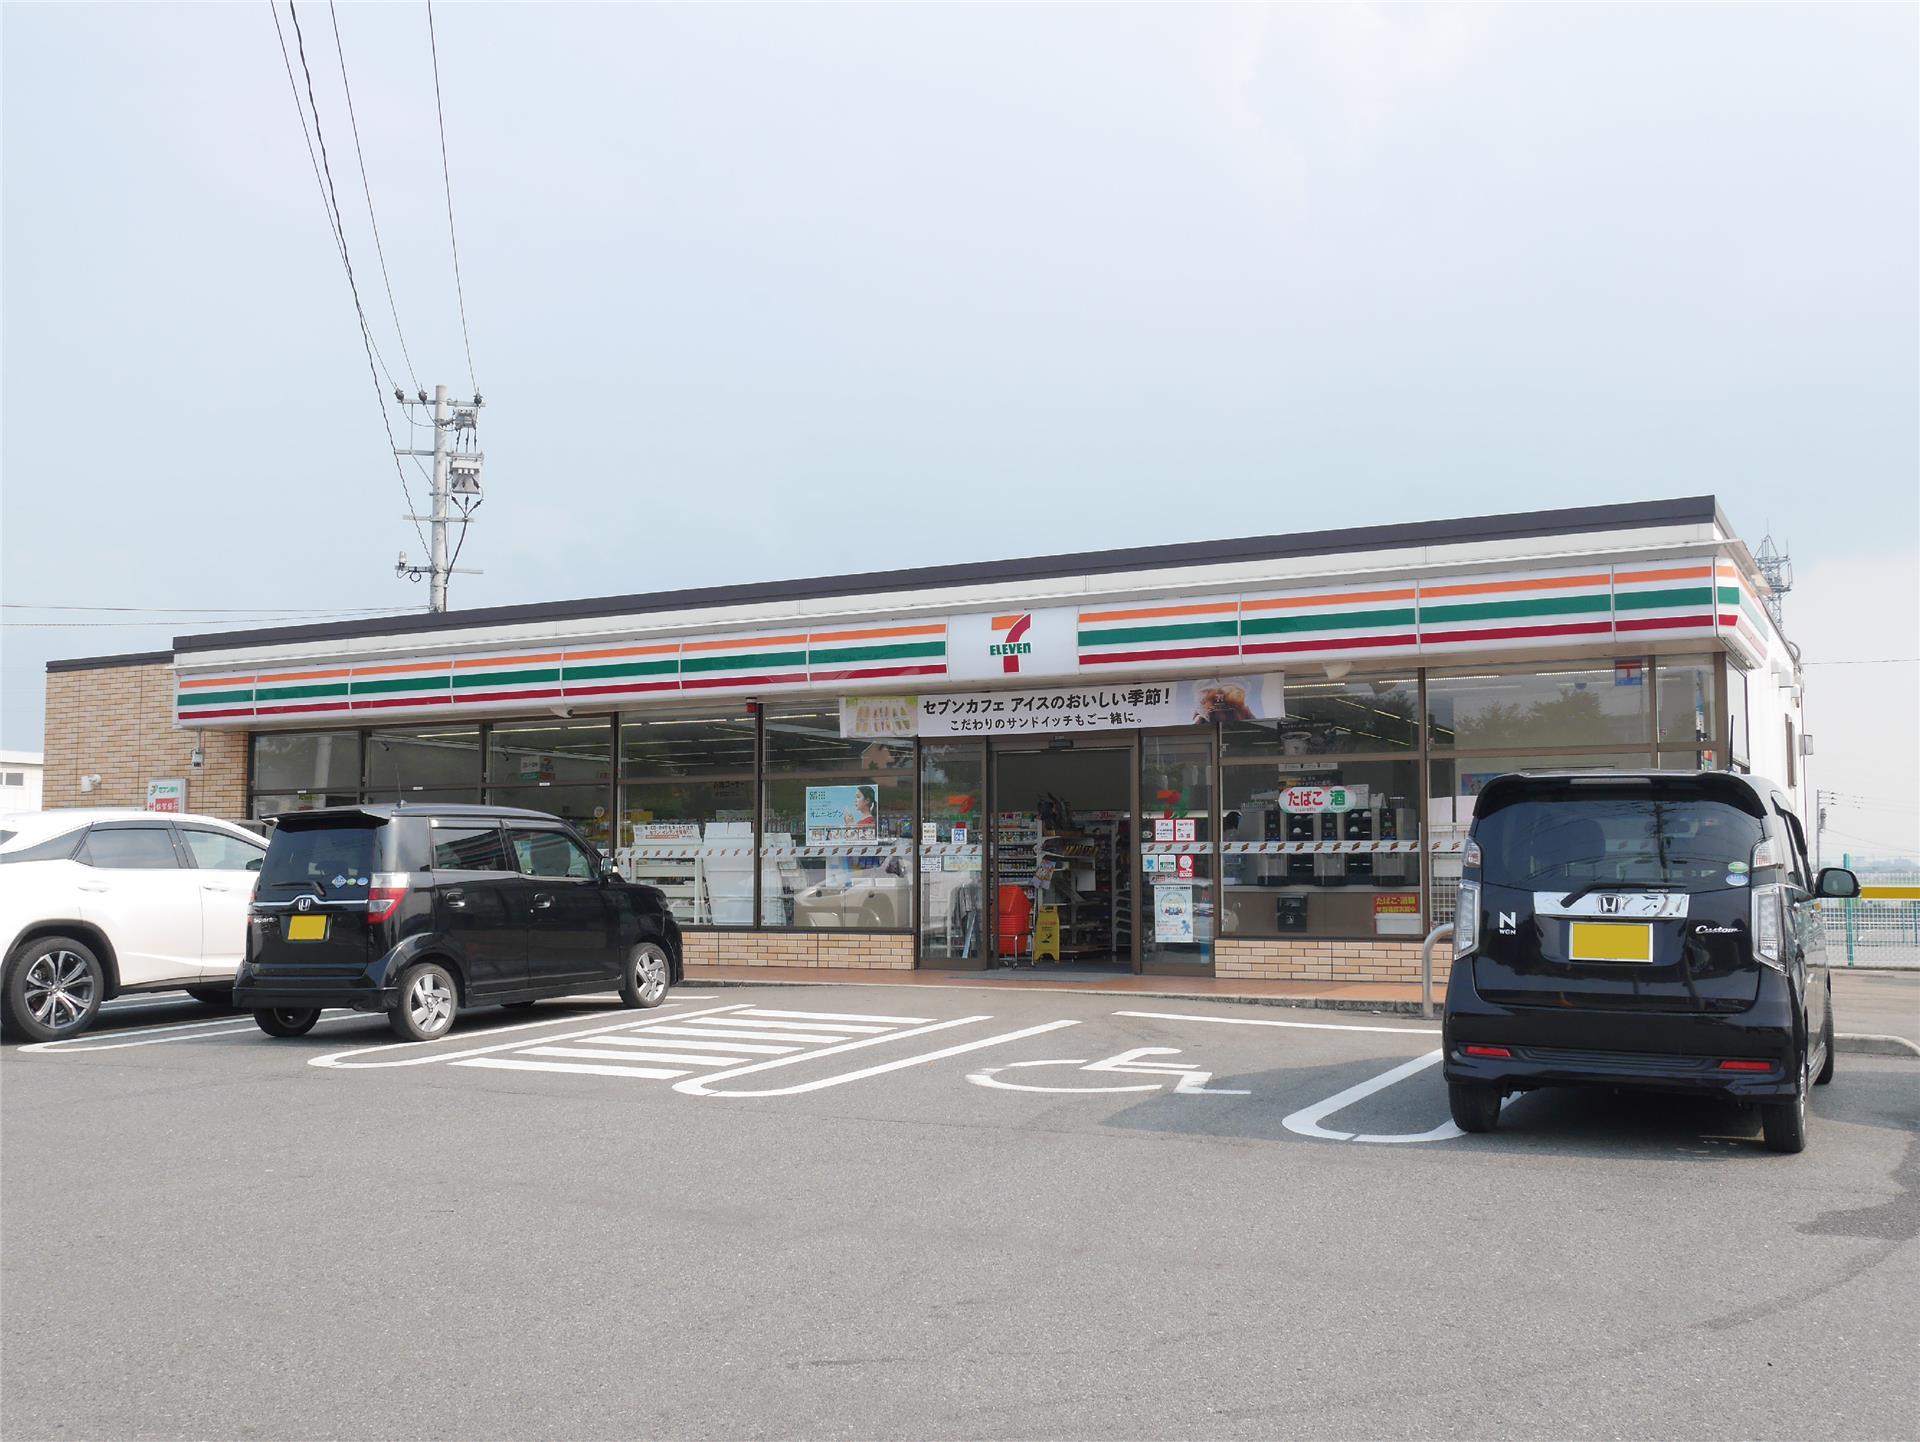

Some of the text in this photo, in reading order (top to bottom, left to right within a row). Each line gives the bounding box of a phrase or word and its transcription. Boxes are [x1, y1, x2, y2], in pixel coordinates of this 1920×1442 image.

[991, 614, 1032, 673] 7
[923, 687, 1171, 715] セブンカフェ アイスのおいしい季節!
[950, 711, 1143, 731] こだわりのサンドイッチもご一緒に。
[1288, 790, 1346, 807] たばこ 酒
[1499, 911, 1517, 929] N
[1695, 925, 1743, 935] Custom
